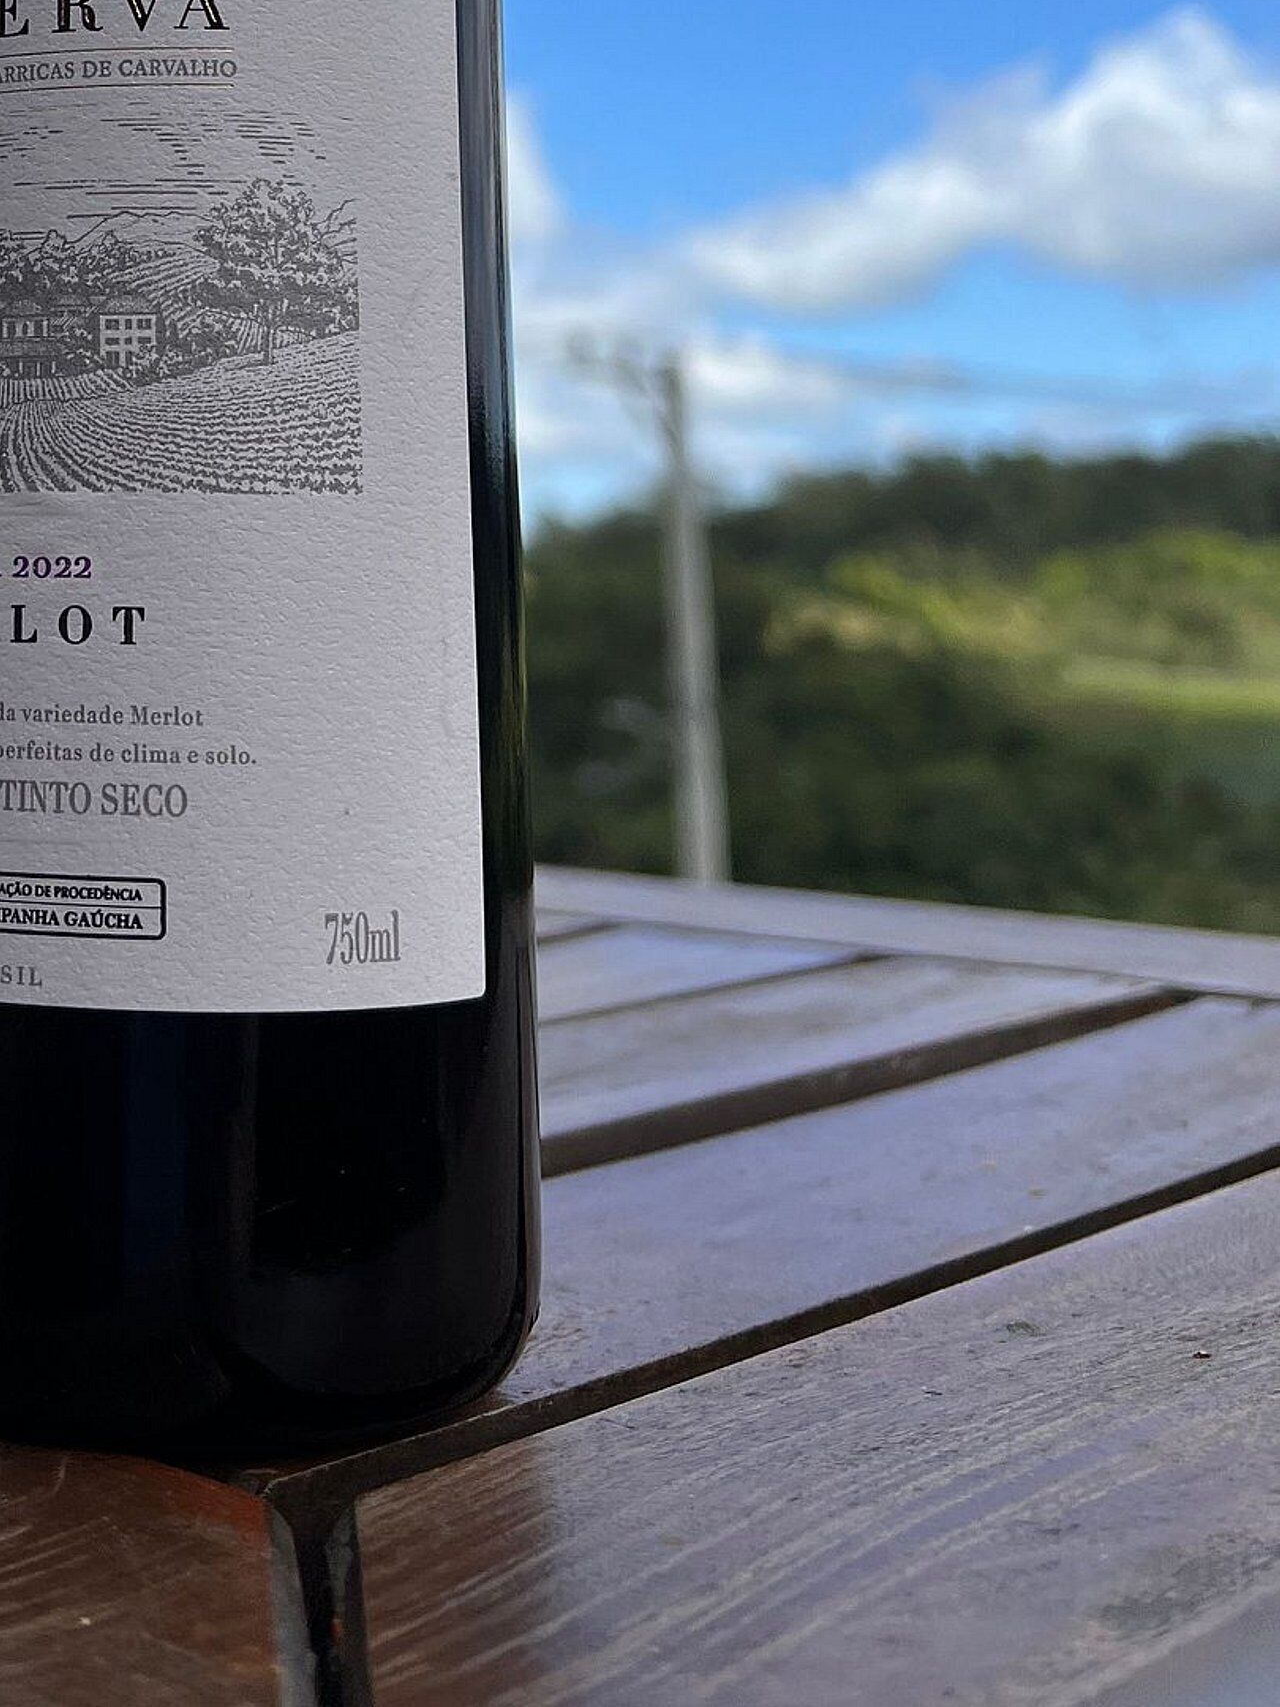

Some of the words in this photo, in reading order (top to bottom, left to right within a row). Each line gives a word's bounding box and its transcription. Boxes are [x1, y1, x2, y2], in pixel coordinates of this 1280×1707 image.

[81, 59, 113, 78] DE
[118, 58, 238, 78] CARVALHO
[11, 555, 93, 580] 2022
[20, 702, 124, 725] variedade
[130, 705, 205, 727] Merlot
[89, 742, 115, 763] de
[120, 743, 182, 764] clima
[186, 749, 200, 764] e
[204, 744, 258, 765] solo.
[100, 782, 189, 818] SECO
[34, 884, 53, 898] DE
[53, 884, 144, 902] PROCEDÊNCIA
[63, 908, 144, 930] GAÚCHA
[324, 910, 403, 966] 750ml
